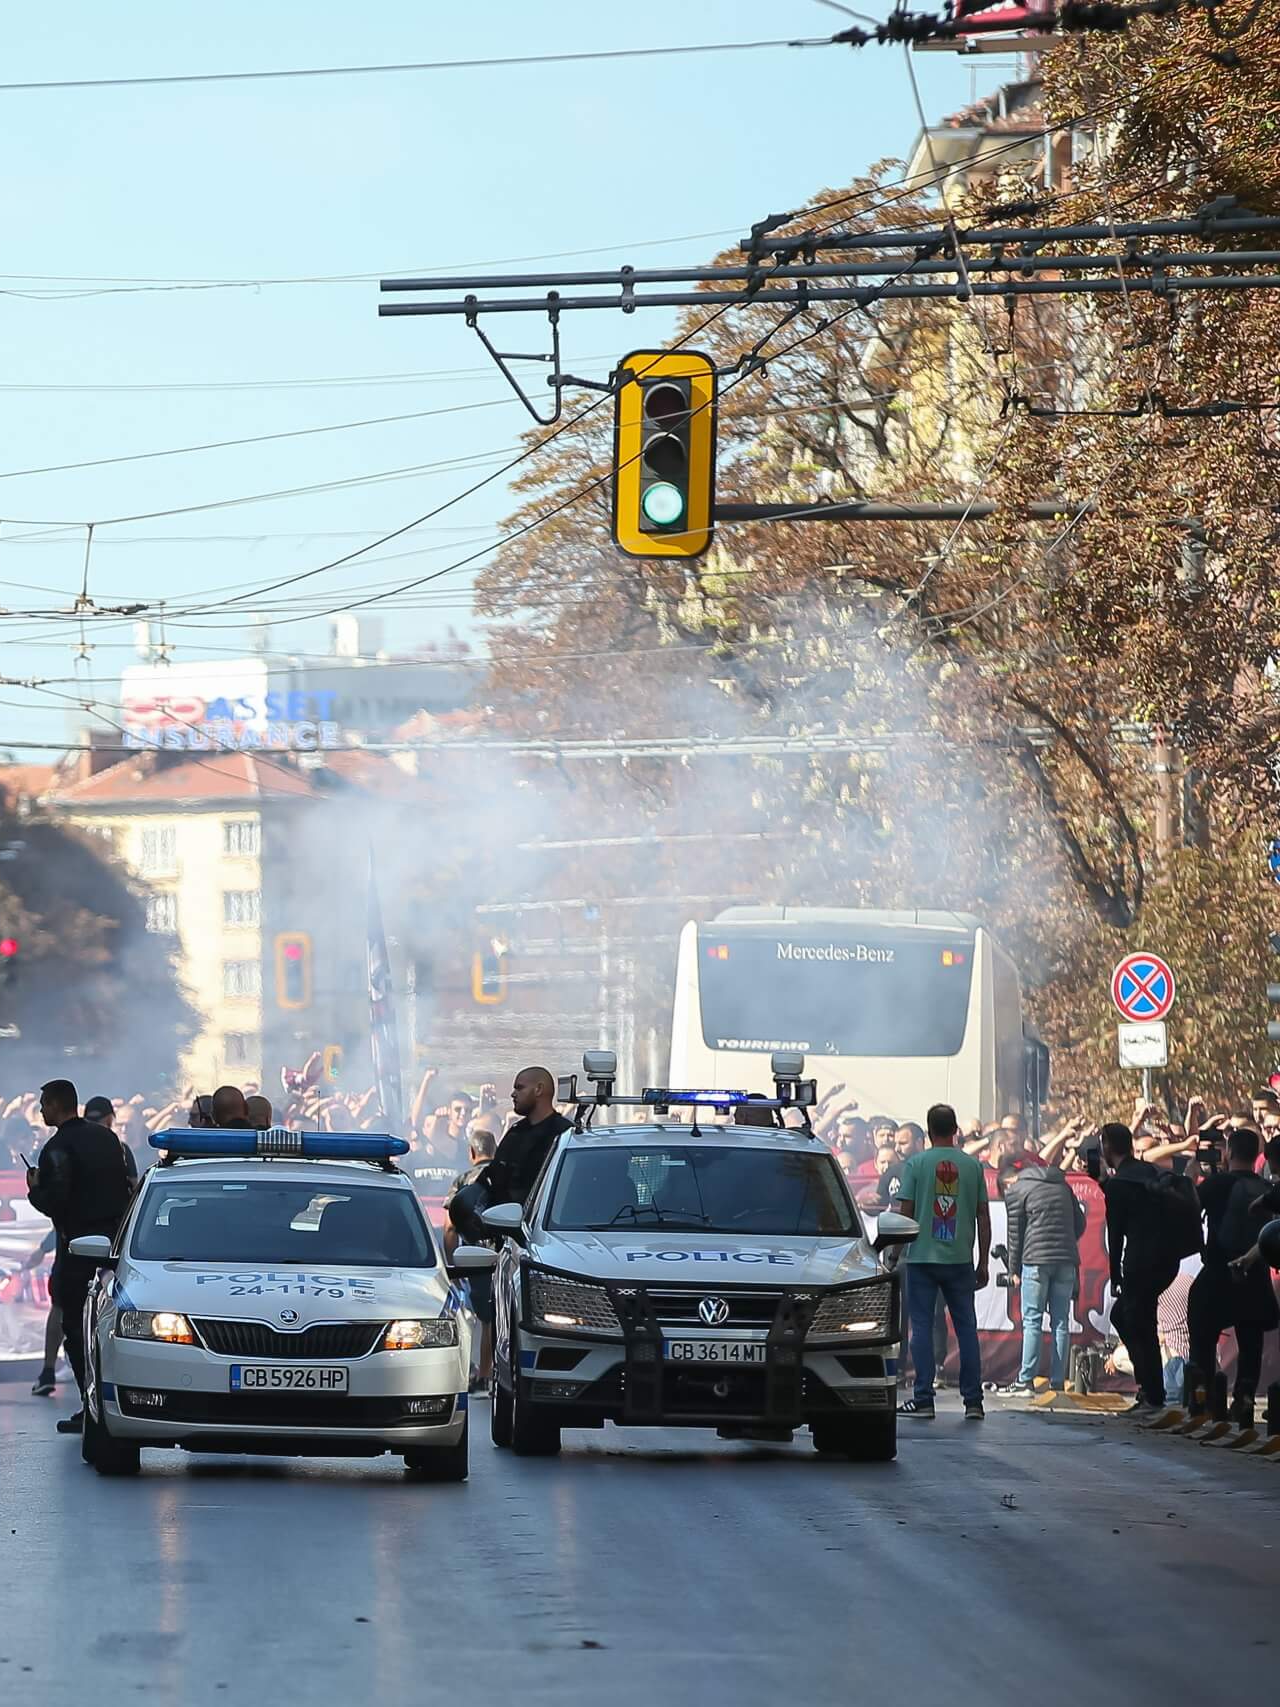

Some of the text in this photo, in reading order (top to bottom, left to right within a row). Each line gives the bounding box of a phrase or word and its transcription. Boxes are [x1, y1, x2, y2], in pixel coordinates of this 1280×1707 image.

[206, 690, 337, 720] ASSET
[122, 720, 339, 749] INSURANCE
[776, 942, 895, 962] Mercedes-Benz
[717, 1039, 810, 1051] TOURISMO
[626, 1251, 795, 1266] POLICE
[196, 1273, 376, 1289] POLICE
[230, 1284, 344, 1299] 24-1179
[671, 1343, 767, 1361] CB 3614 MT
[243, 1368, 344, 1388] CB 5926 HP
